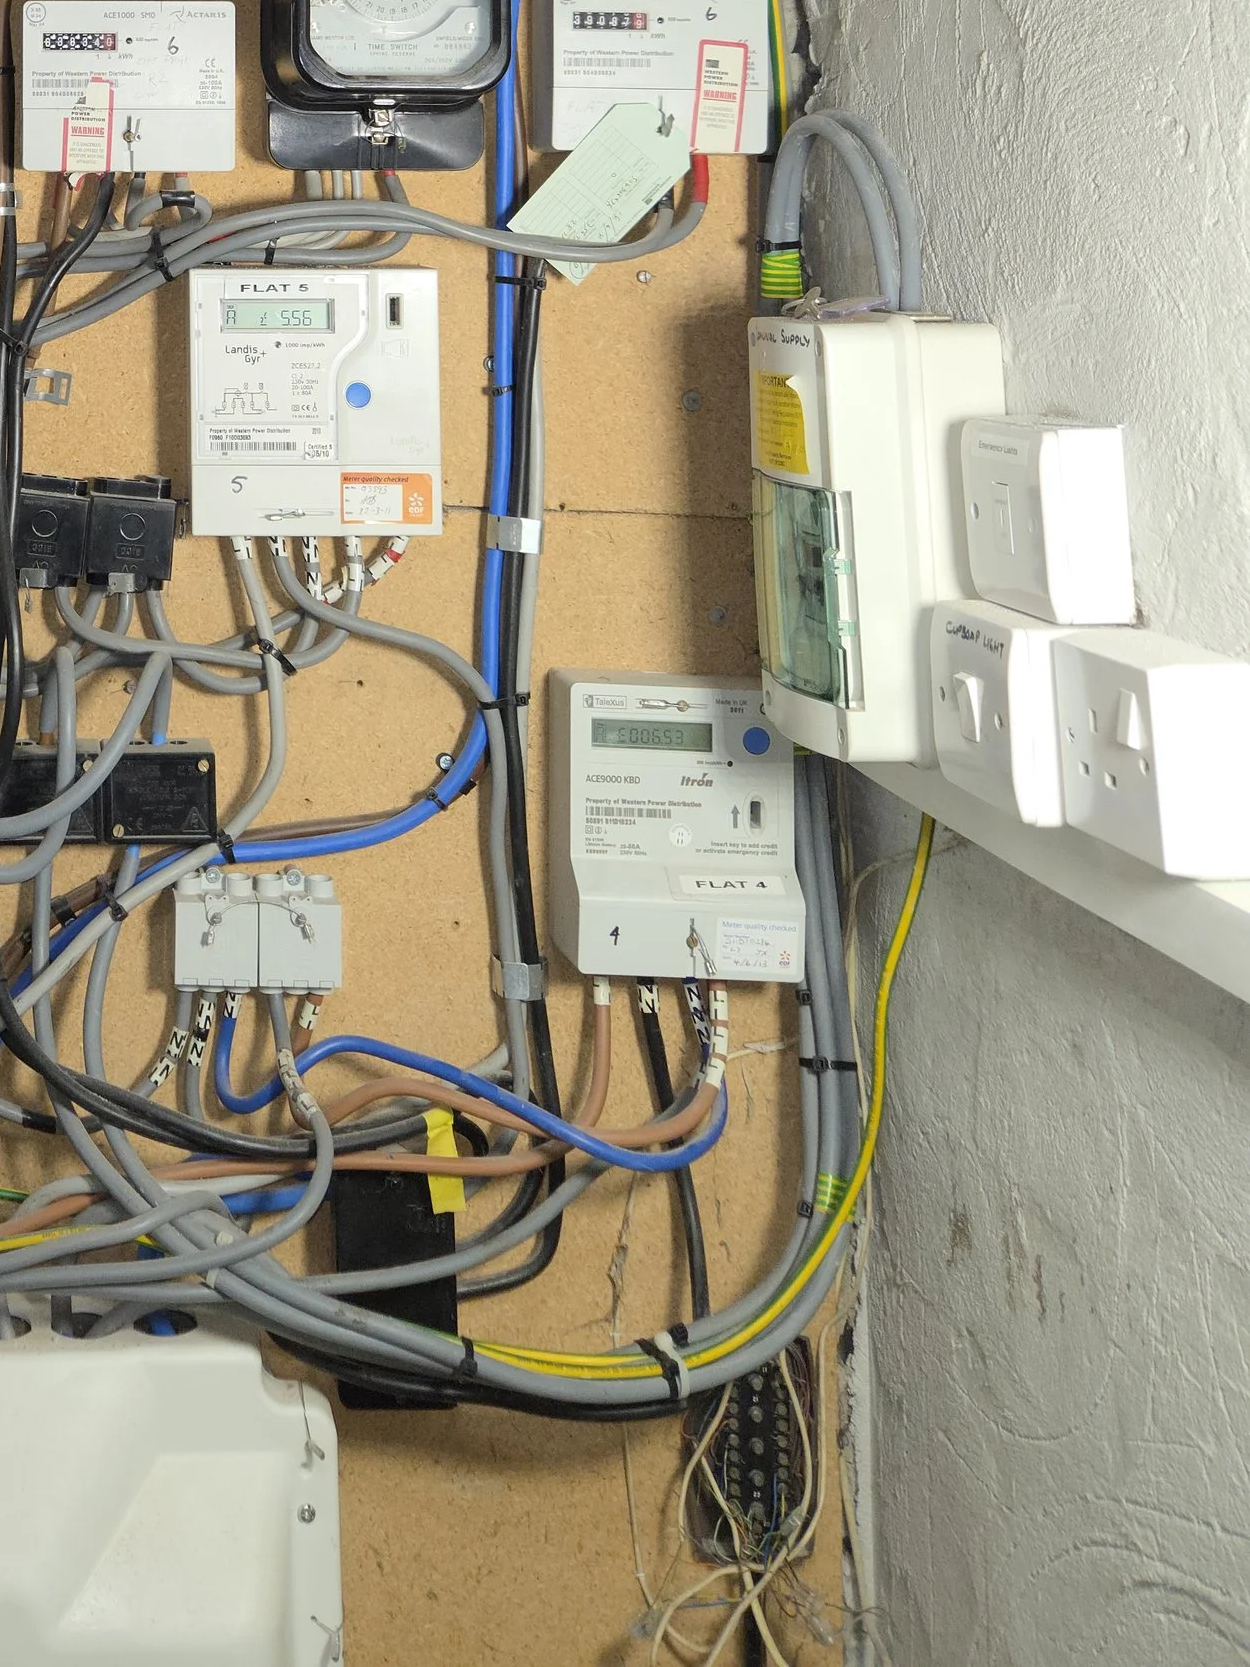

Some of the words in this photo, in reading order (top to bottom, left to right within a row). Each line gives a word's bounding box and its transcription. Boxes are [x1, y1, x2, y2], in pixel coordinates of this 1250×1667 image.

[705, 7, 717, 21] 6
[167, 36, 179, 55] 6
[31, 70, 56, 78] Property
[57, 70, 64, 78] of
[65, 70, 88, 78] Western
[89, 70, 107, 78] Power
[108, 70, 142, 78] Distribution
[703, 89, 737, 100] WARNING
[70, 126, 105, 135] WARNING
[240, 284, 291, 293] FLAT
[299, 284, 310, 292] 5
[225, 344, 258, 354] Landis
[362, 476, 382, 484] quality
[383, 475, 409, 483] checked
[231, 476, 248, 493] 5
[585, 775, 622, 784] ACE9000
[624, 775, 641, 784] KBD
[585, 797, 611, 806] Property
[695, 880, 748, 889] FLAT
[755, 880, 768, 889] 4
[722, 920, 742, 929] Meter
[743, 921, 767, 932] quality
[769, 924, 797, 932] checked
[608, 926, 621, 946] 4
